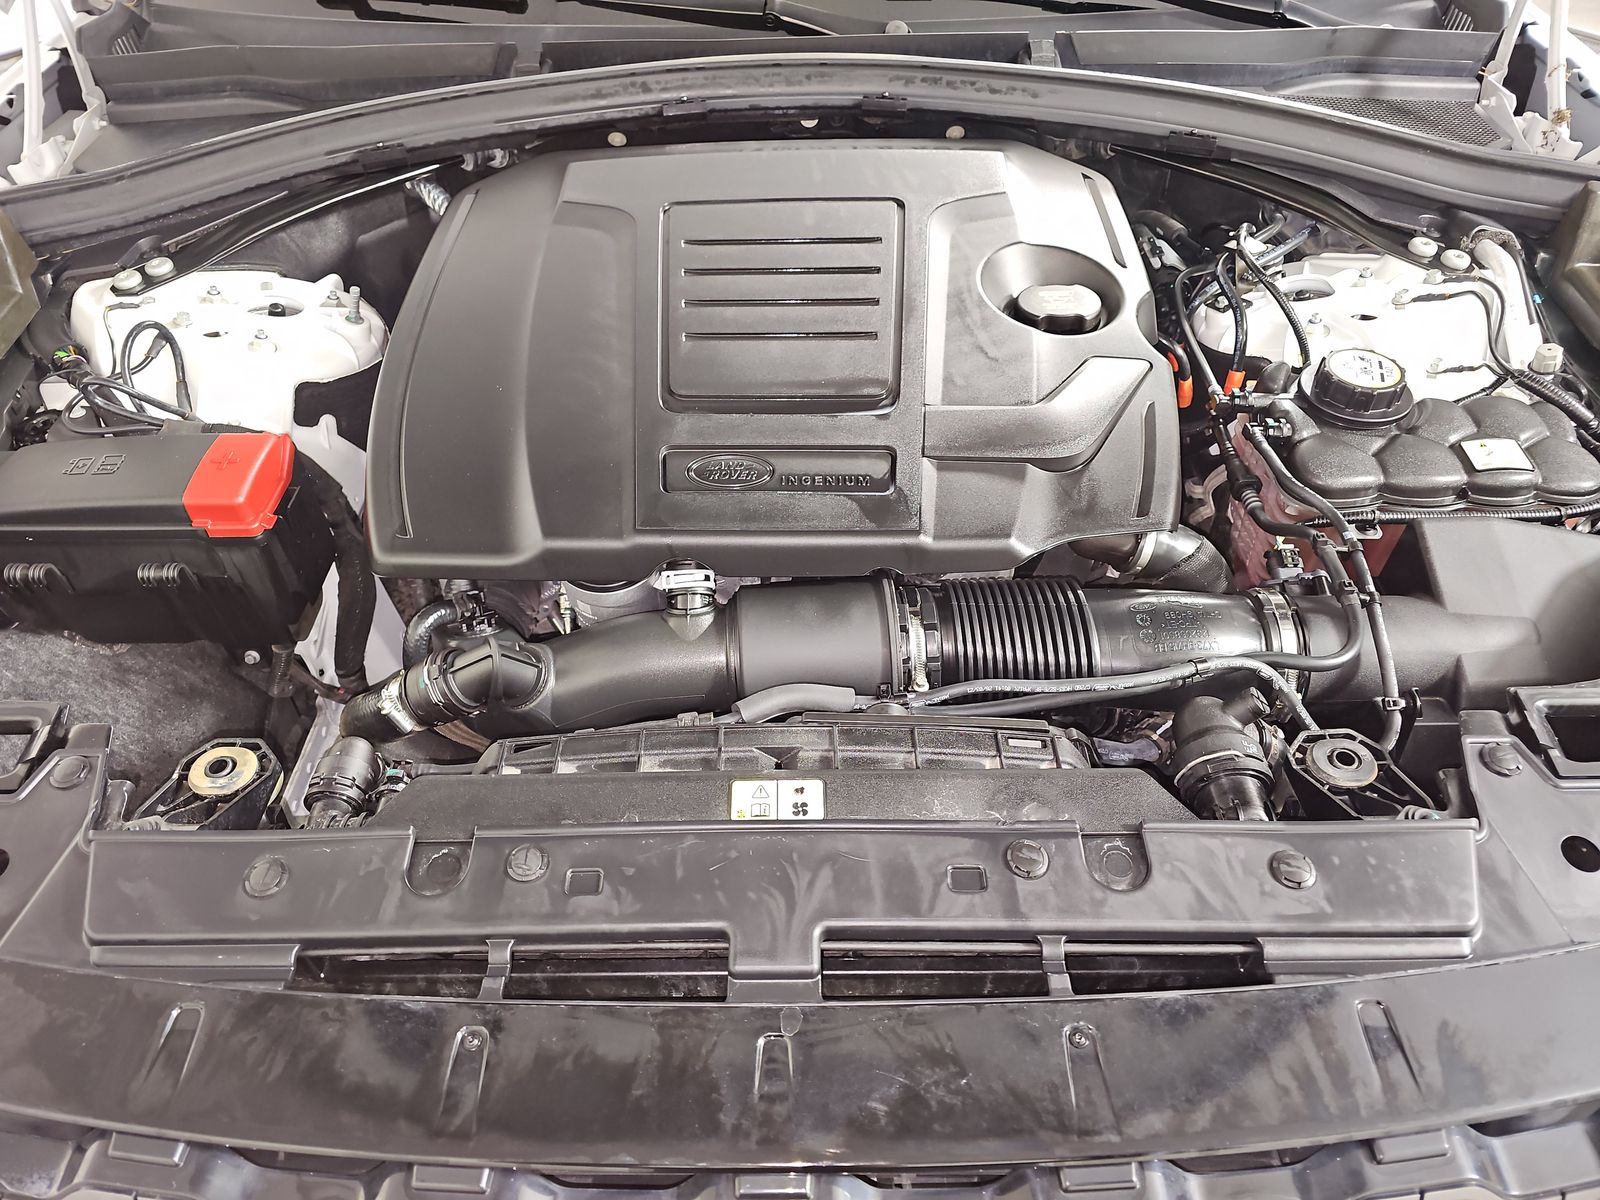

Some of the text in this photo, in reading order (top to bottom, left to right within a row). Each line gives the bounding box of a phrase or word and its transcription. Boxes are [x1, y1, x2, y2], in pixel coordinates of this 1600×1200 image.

[706, 460, 745, 470] LAND
[707, 470, 758, 480] ROVER
[781, 474, 871, 486] INGENIUM
